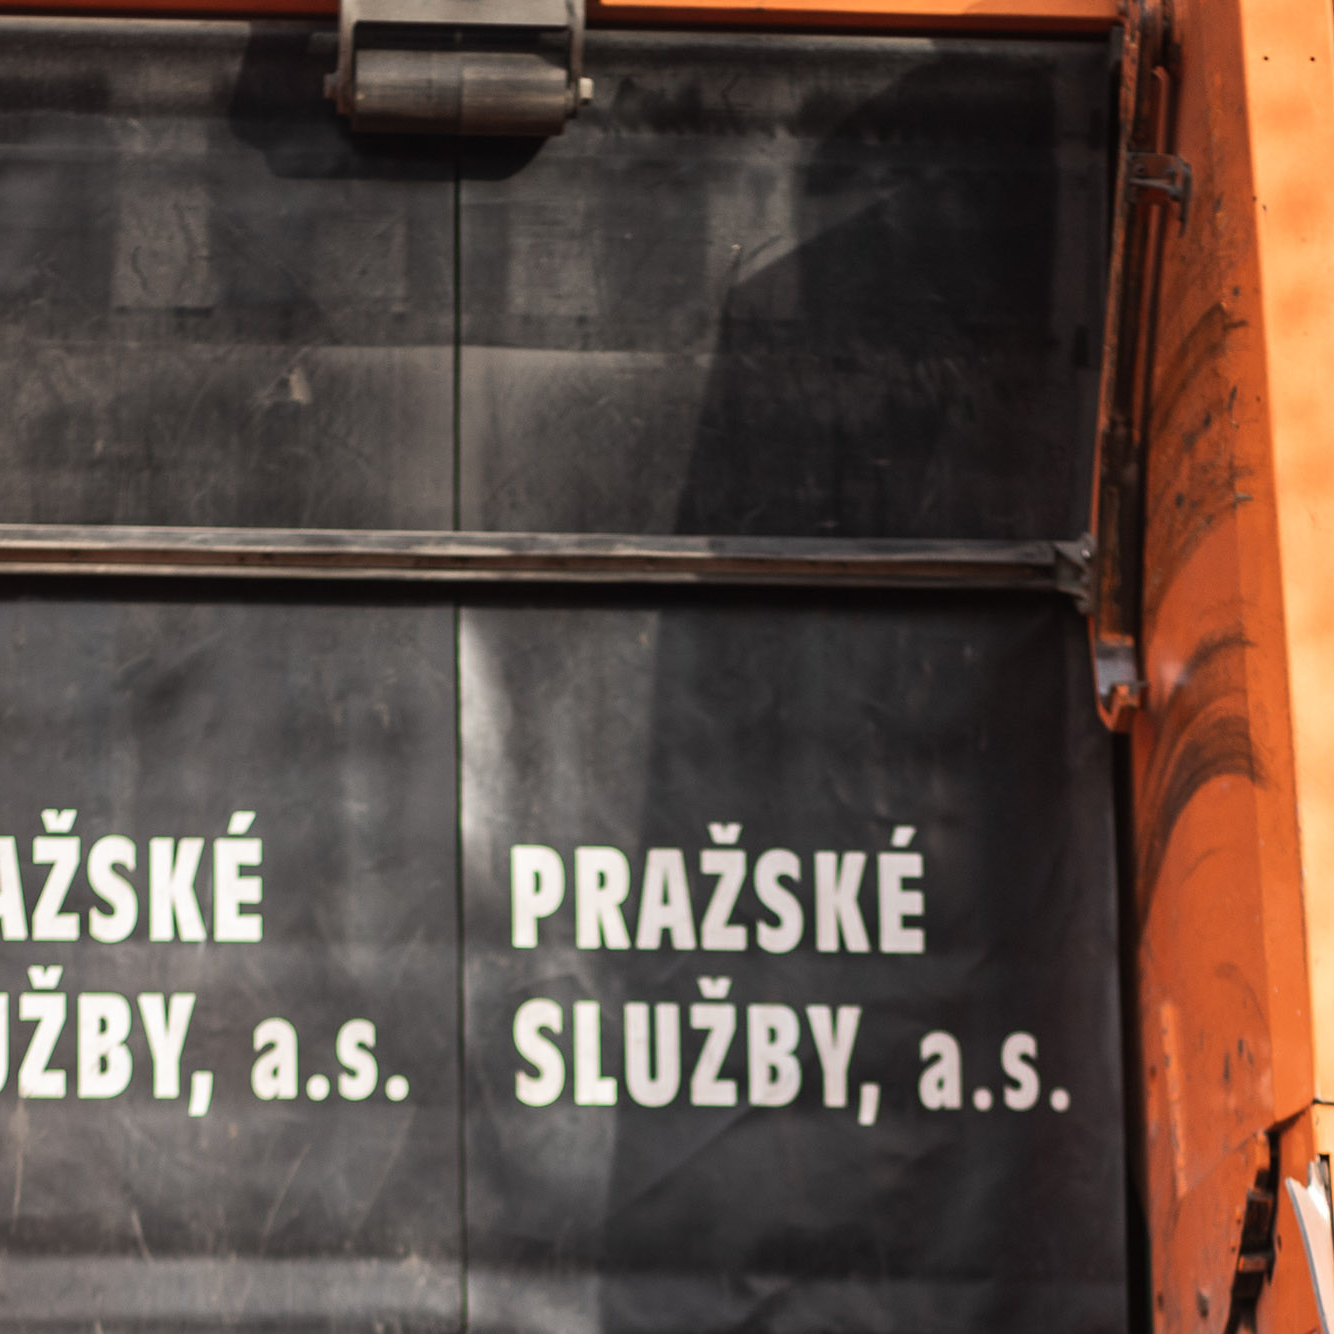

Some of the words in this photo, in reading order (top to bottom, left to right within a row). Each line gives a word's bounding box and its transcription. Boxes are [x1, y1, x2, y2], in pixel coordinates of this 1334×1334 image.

[510, 823, 926, 954] PRAŽSKÉ
[251, 1017, 411, 1102] a.s.
[513, 976, 882, 1126] SLUŽBY,
[917, 1029, 1072, 1112] a.s.
